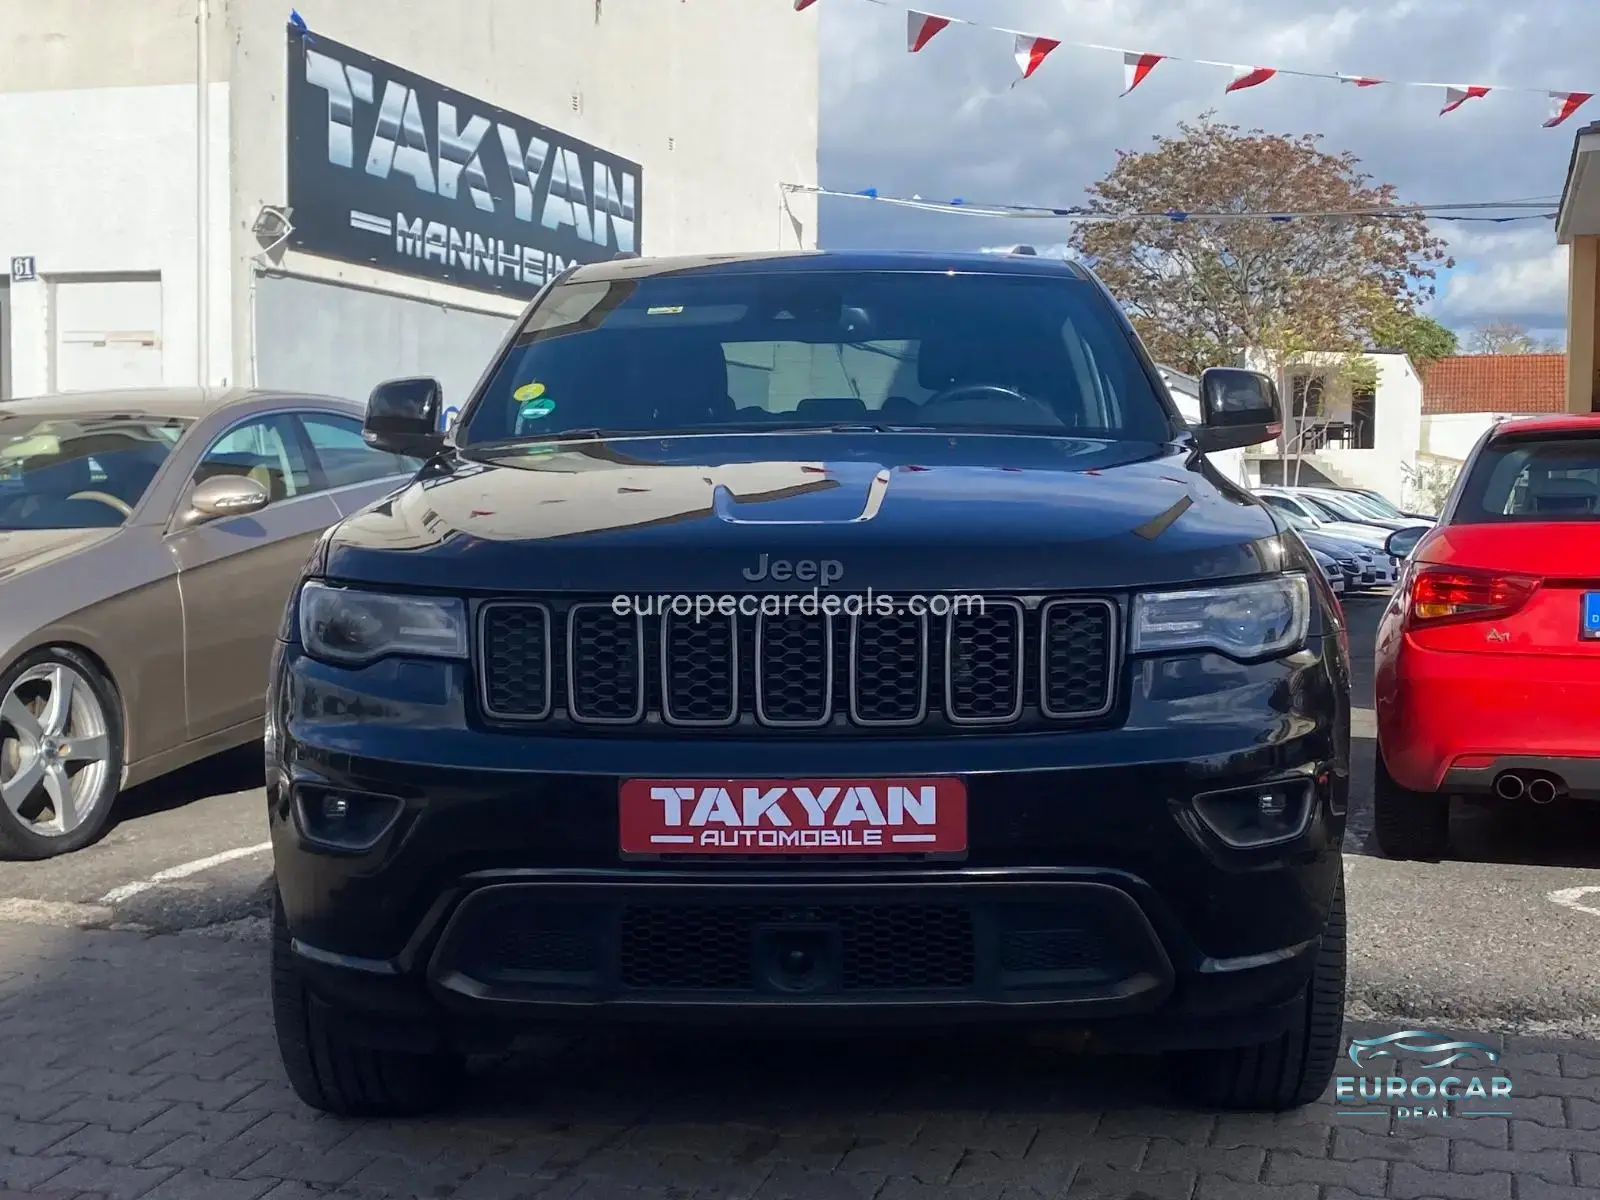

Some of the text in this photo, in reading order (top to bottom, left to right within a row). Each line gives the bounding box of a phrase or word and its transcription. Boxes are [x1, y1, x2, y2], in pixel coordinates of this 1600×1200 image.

[306, 50, 635, 253] TAKYAN
[14, 258, 33, 275] 61
[742, 553, 845, 586] Jeep
[650, 786, 937, 827] TAKYAN
[700, 829, 883, 847] AUTOMOBILE
